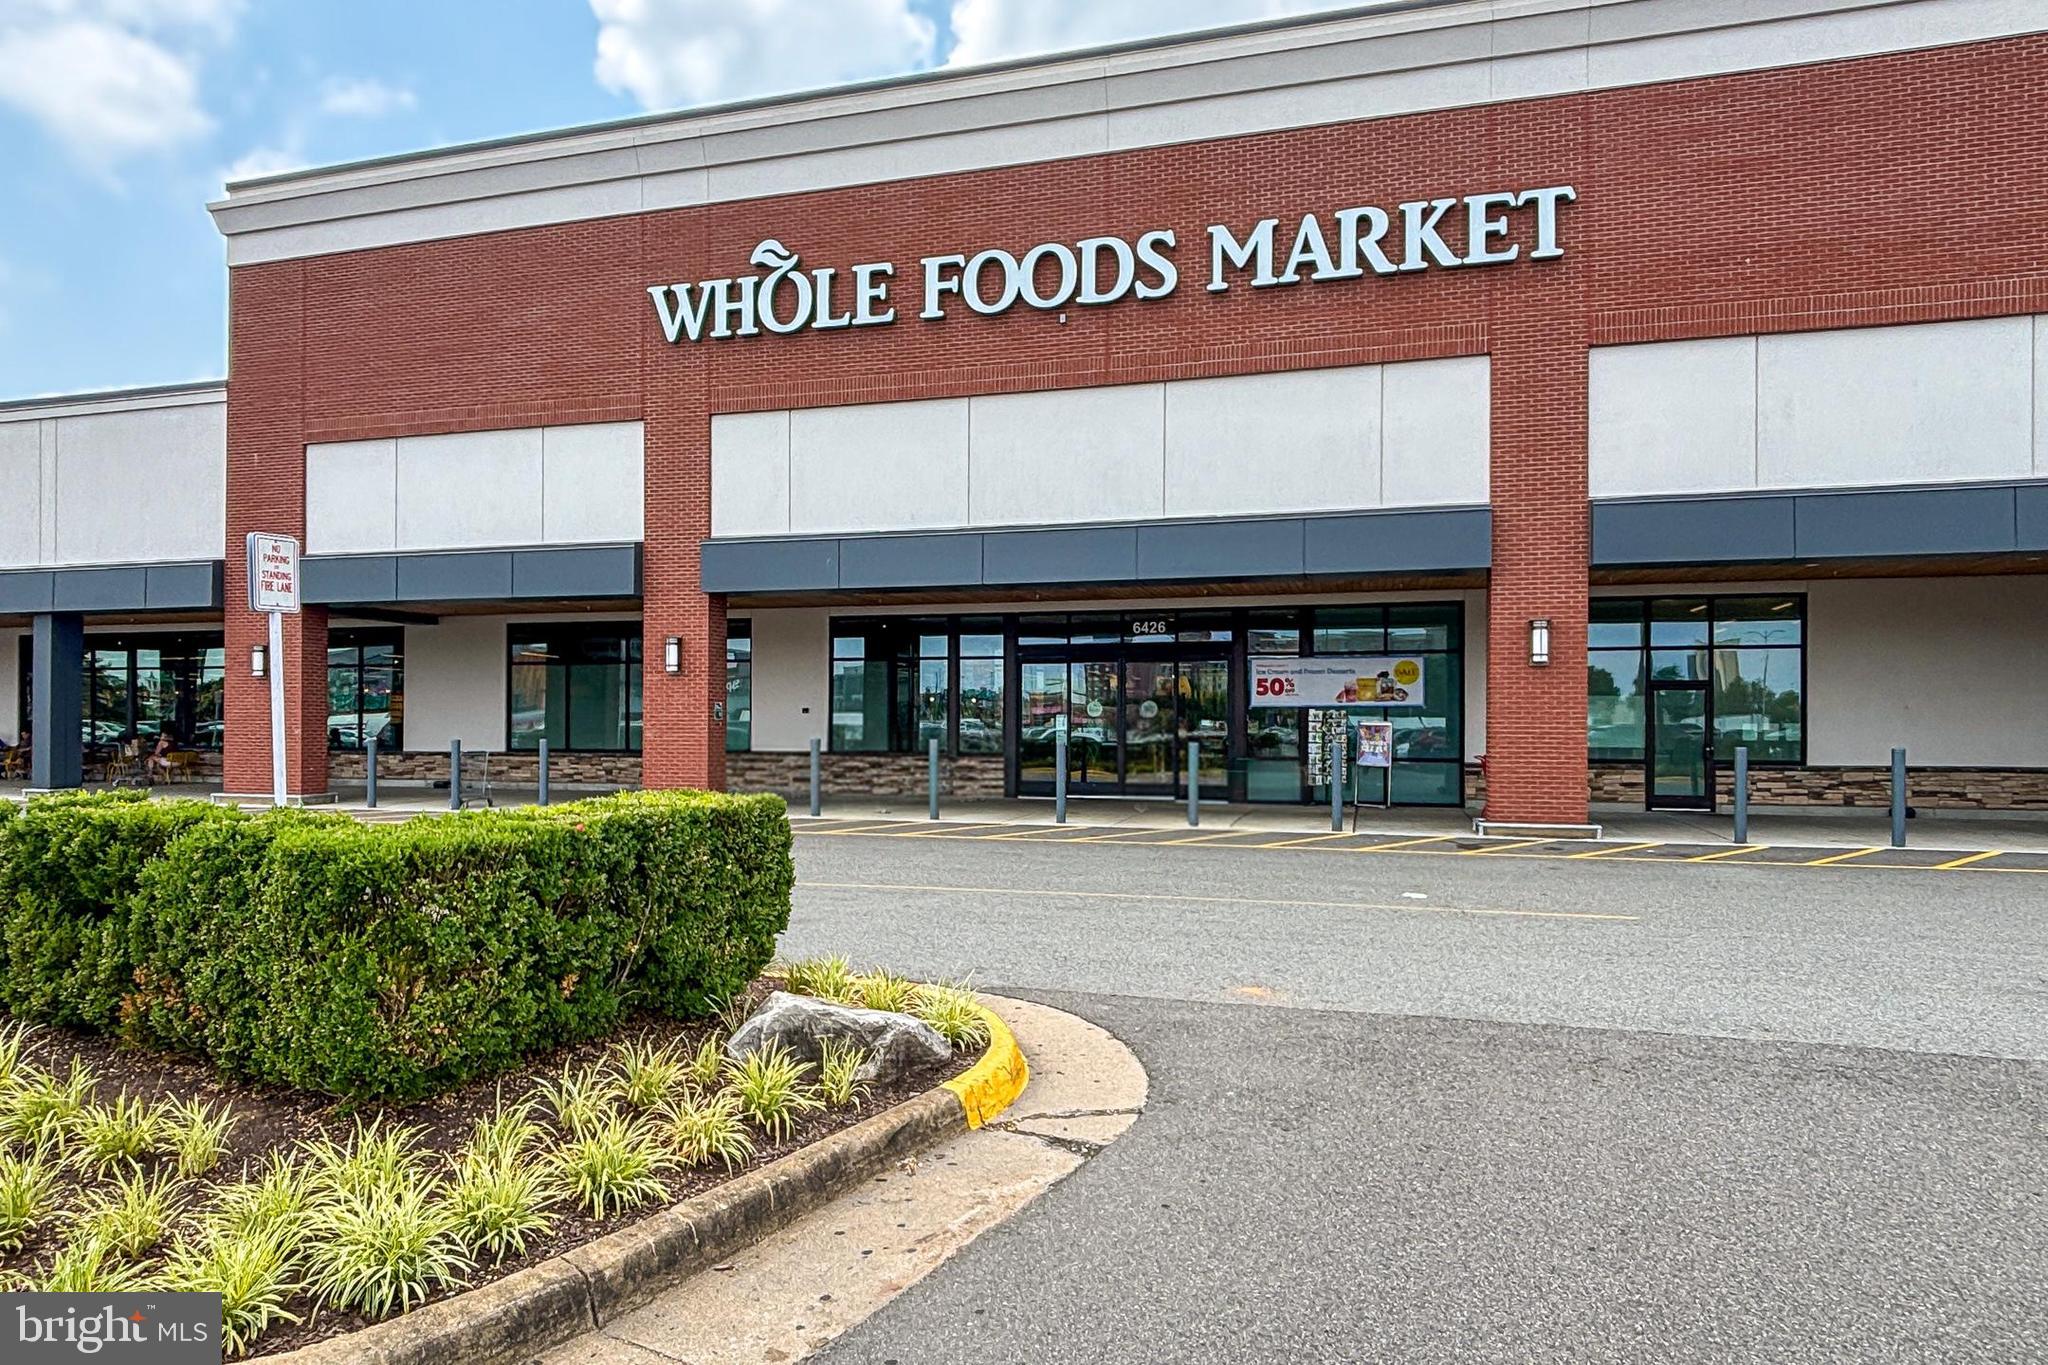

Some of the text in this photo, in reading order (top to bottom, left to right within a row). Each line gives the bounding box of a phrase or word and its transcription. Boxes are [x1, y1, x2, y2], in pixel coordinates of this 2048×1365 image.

[647, 185, 1577, 343] WHOLE FOODS MARKET
[271, 544, 281, 553] NO
[263, 554, 290, 565] PARKING
[261, 570, 292, 581] STANDING
[261, 581, 293, 593] FIRE LANE
[1132, 621, 1167, 634] 6426
[1290, 667, 1303, 675] and
